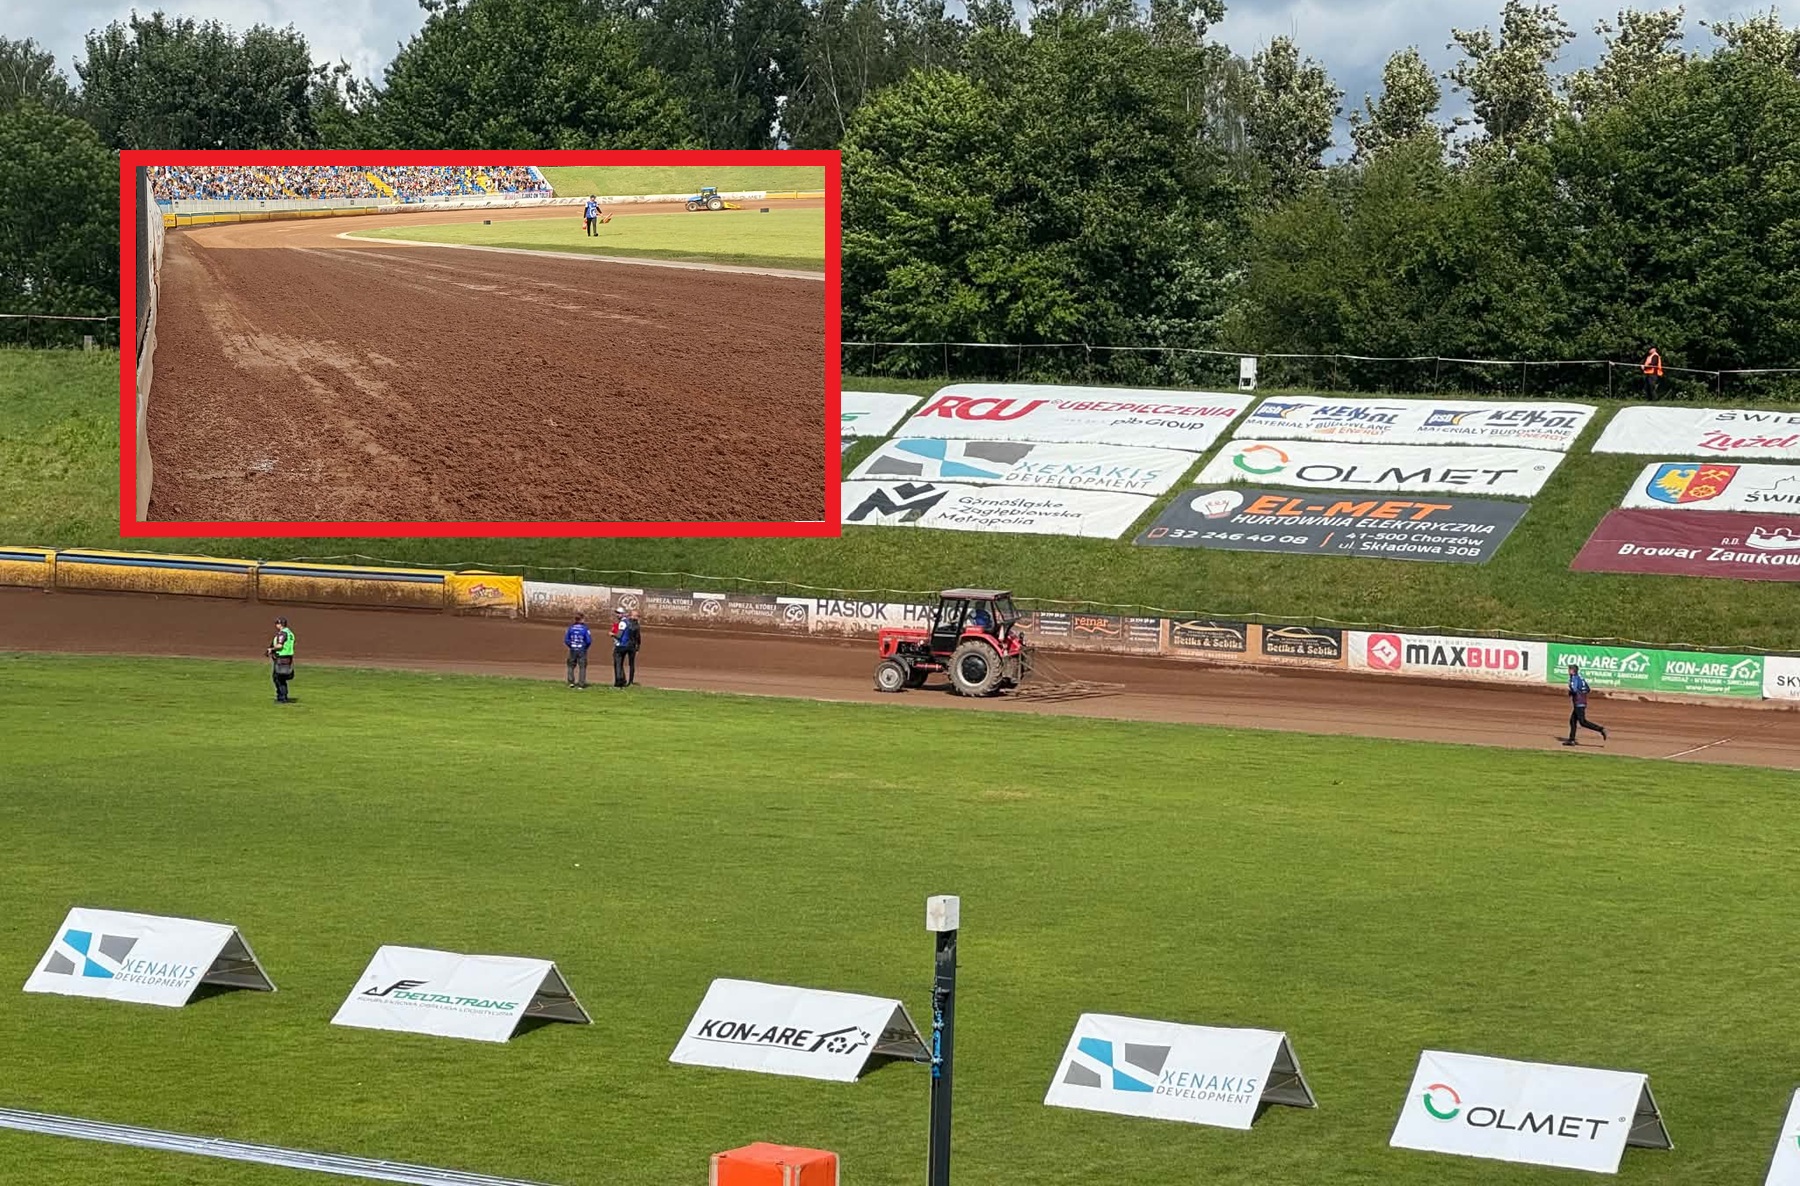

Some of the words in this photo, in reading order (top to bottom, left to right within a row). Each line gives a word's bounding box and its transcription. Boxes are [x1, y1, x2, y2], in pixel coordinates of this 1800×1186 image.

[912, 396, 1050, 420] RCU
[1057, 400, 1237, 417] UBEZPIECZENIA
[1145, 418, 1204, 431] Group
[1246, 419, 1313, 429] MATERIAŁY
[1315, 421, 1392, 431] BUDOWLANE
[1490, 428, 1573, 436] BUDOWLANE
[1015, 461, 1163, 481] XENAKIS
[1296, 465, 1518, 485] OLMET
[1005, 472, 1152, 489] DEVELOPMENT
[1244, 495, 1452, 521] EL-MET
[938, 512, 1034, 526] Metropolia
[1231, 513, 1354, 528] HURTOWNIA
[1356, 518, 1495, 534] ELEKTRYCZNA
[1169, 529, 1199, 539] 32
[1202, 532, 1244, 541] 246
[1247, 534, 1276, 543] 40
[1279, 535, 1308, 544] 08
[1346, 532, 1408, 541] 41-500
[1411, 534, 1484, 546] Chorzów
[1721, 537, 1740, 545] A.D.
[1339, 541, 1355, 549] ul.
[1360, 541, 1441, 554] Składowa
[1445, 547, 1480, 557] 30B
[1617, 543, 1702, 559] Browar
[816, 599, 887, 620] HASIOK
[1075, 617, 1108, 627] remar
[1203, 638, 1211, 647] &
[1297, 645, 1305, 654] &
[1558, 654, 1618, 669] KON-ARE
[1666, 661, 1728, 676] KON-ARE
[1777, 675, 1800, 687] SK
[121, 959, 197, 979] XENAKIS
[115, 972, 190, 988] DEVELOPMENT
[698, 1019, 813, 1047] KON-ARE
[1161, 1070, 1257, 1093] XENAKIS
[1156, 1086, 1252, 1105] DEVELOPMENT
[1466, 1106, 1609, 1140] OLMET
